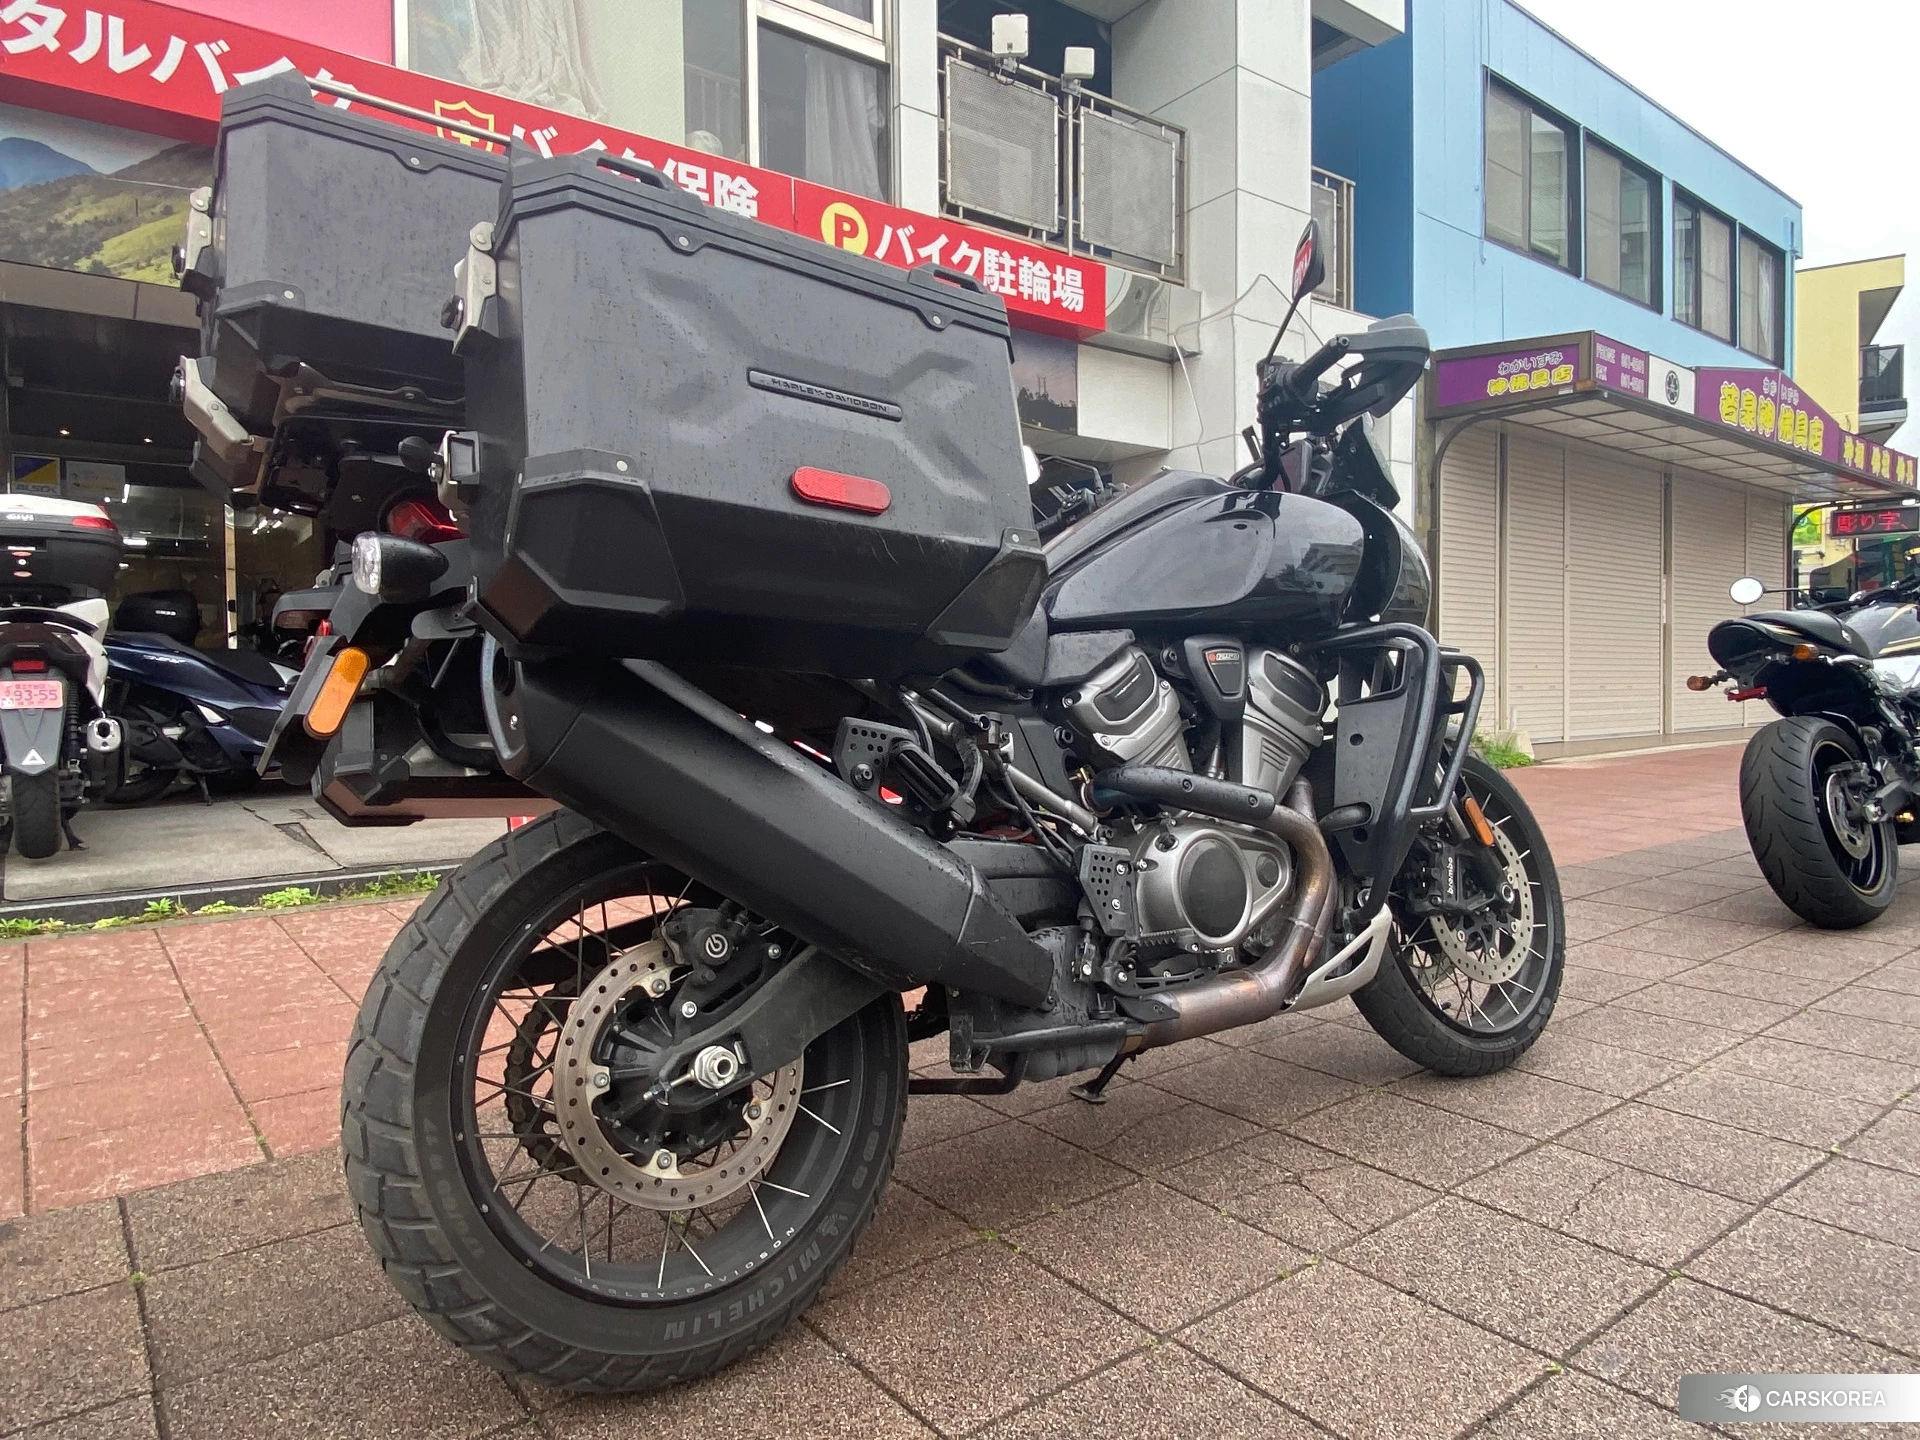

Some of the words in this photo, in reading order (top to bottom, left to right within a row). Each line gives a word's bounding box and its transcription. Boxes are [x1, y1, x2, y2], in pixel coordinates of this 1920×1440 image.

[511, 123, 758, 219] バ保険
[873, 223, 1086, 313] バイク駐輪場
[770, 377, 888, 413] HARLEY-DAVIDSON
[663, 1240, 822, 1341] MICHELIN
